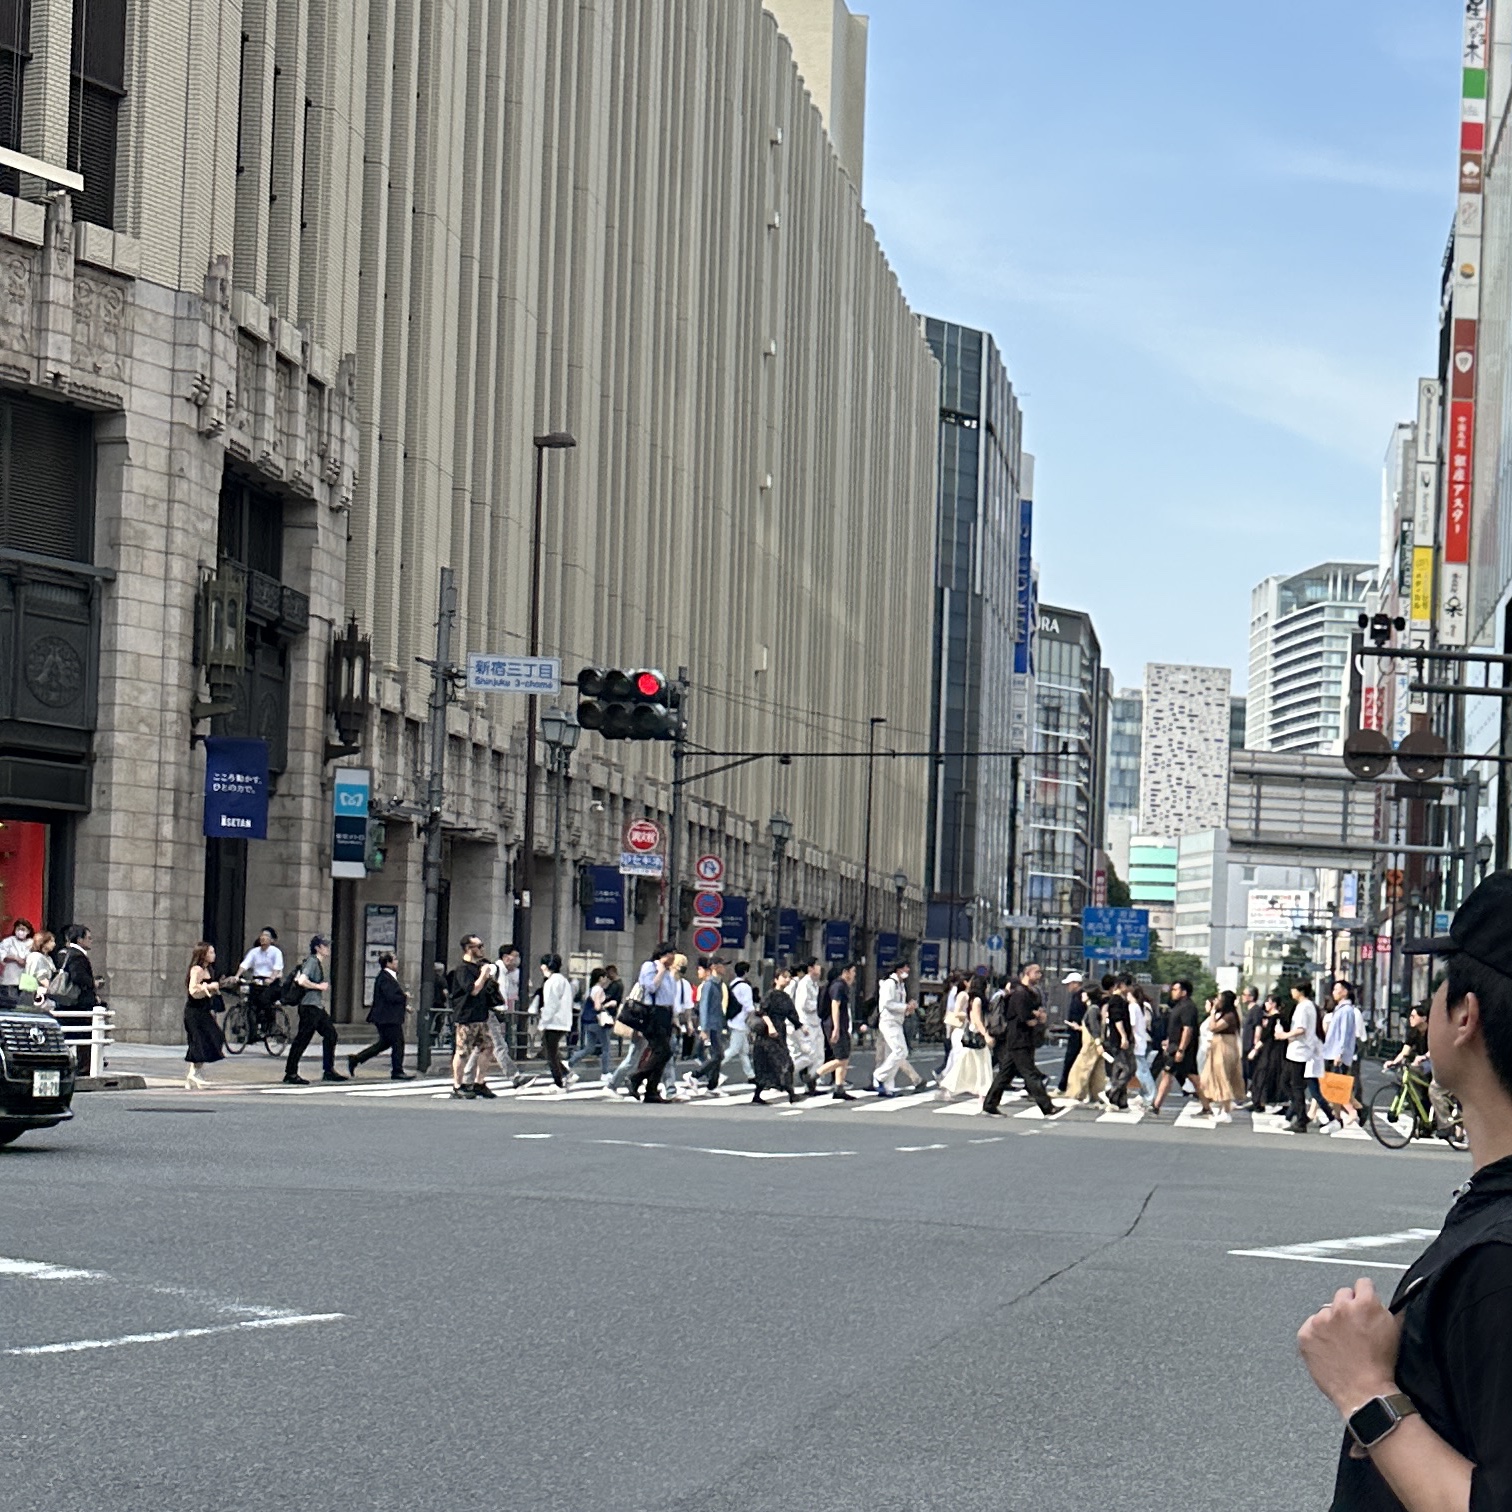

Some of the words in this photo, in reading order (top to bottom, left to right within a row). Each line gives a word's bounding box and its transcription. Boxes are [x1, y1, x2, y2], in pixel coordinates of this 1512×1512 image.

[1036, 616, 1060, 634] RA
[475, 660, 553, 679] 新宿三丁目
